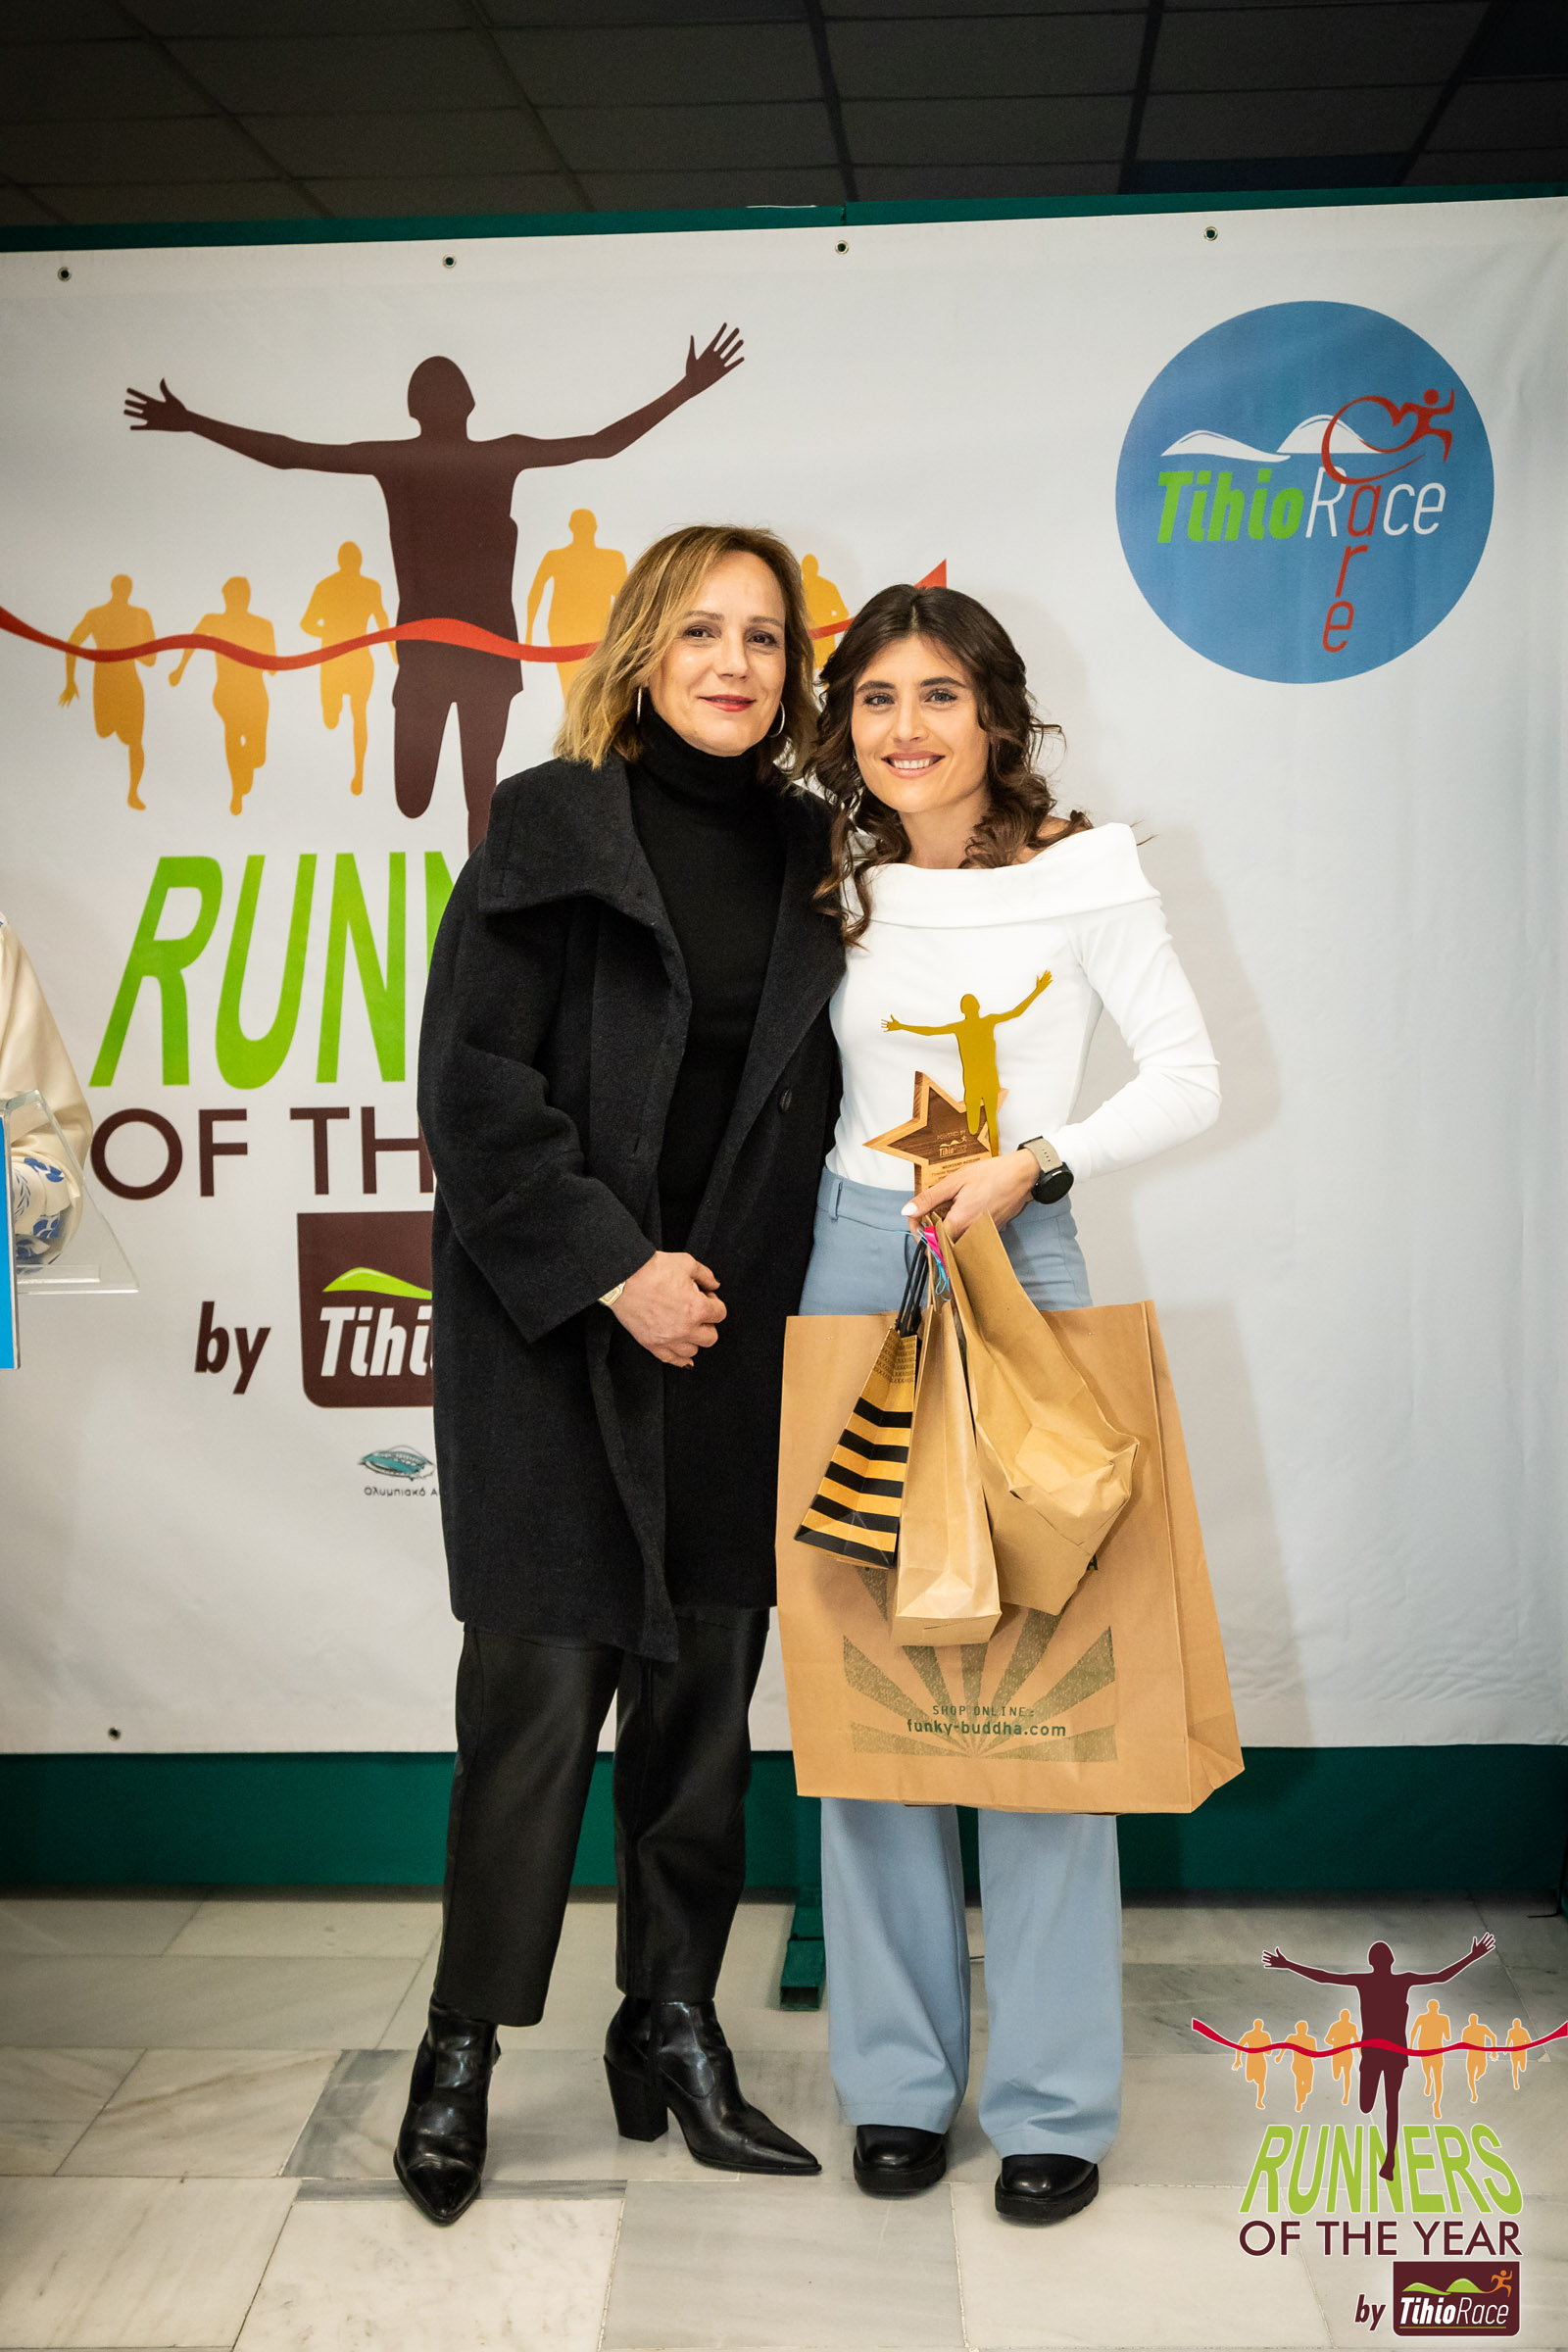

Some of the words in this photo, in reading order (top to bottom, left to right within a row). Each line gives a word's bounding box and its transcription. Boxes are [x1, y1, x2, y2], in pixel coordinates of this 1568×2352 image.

[90, 1107, 248, 1200] OF
[289, 1105, 435, 1196] TH
[194, 1300, 271, 1395] by
[319, 1305, 433, 1377] Tihi
[906, 1718, 1066, 1737] funky-buddha.com
[932, 1705, 966, 1716] SHOP
